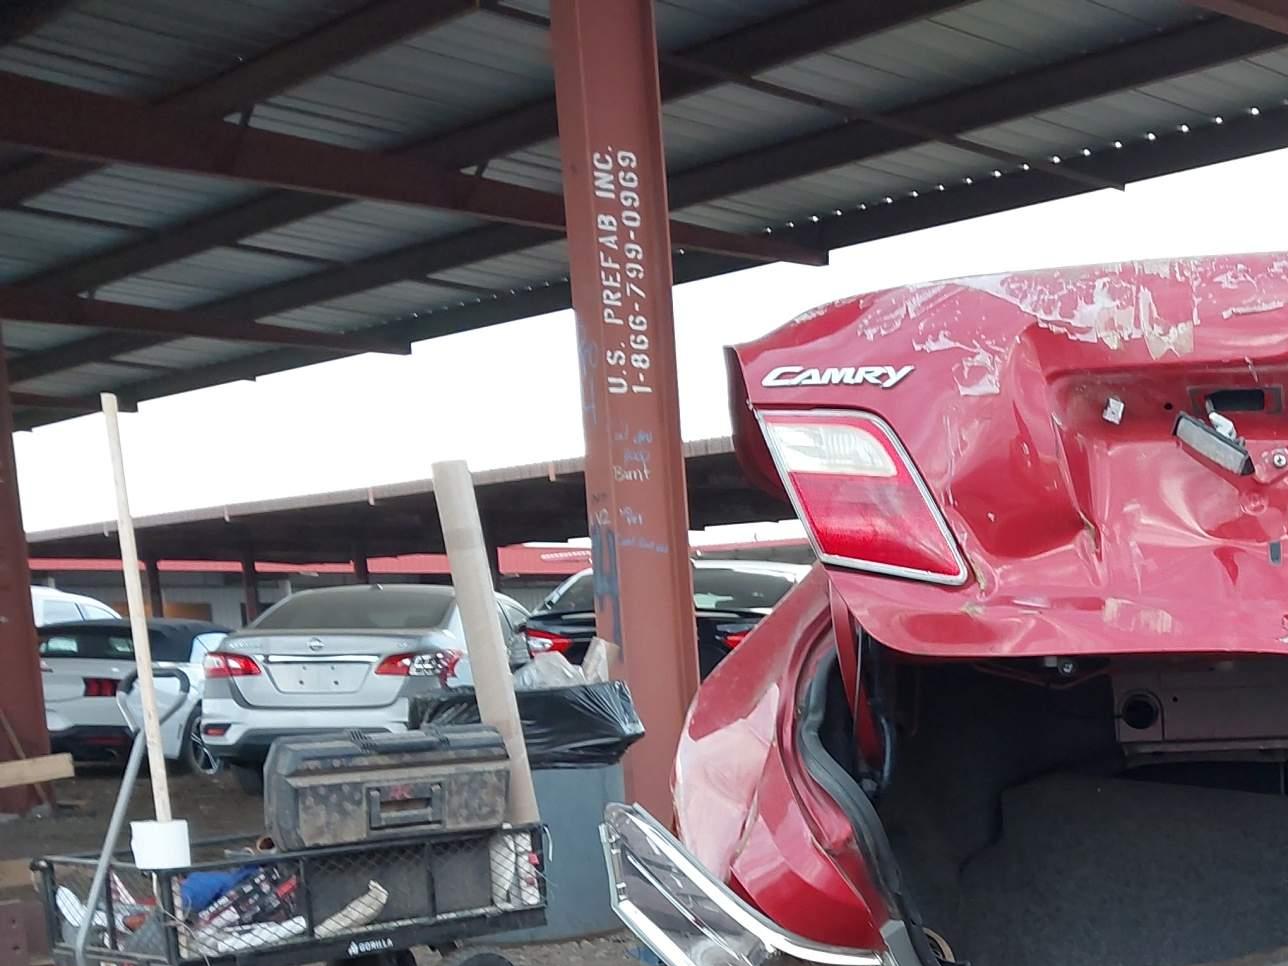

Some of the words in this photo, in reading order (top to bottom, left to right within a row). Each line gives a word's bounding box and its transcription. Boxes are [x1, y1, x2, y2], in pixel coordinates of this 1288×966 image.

[593, 145, 616, 199] INC.
[598, 213, 624, 325] PREFAB
[617, 150, 653, 394] 1-866-799-0969
[606, 341, 628, 394] U.S.
[761, 365, 916, 388] CAMRY
[359, 938, 394, 953] GORILLA
